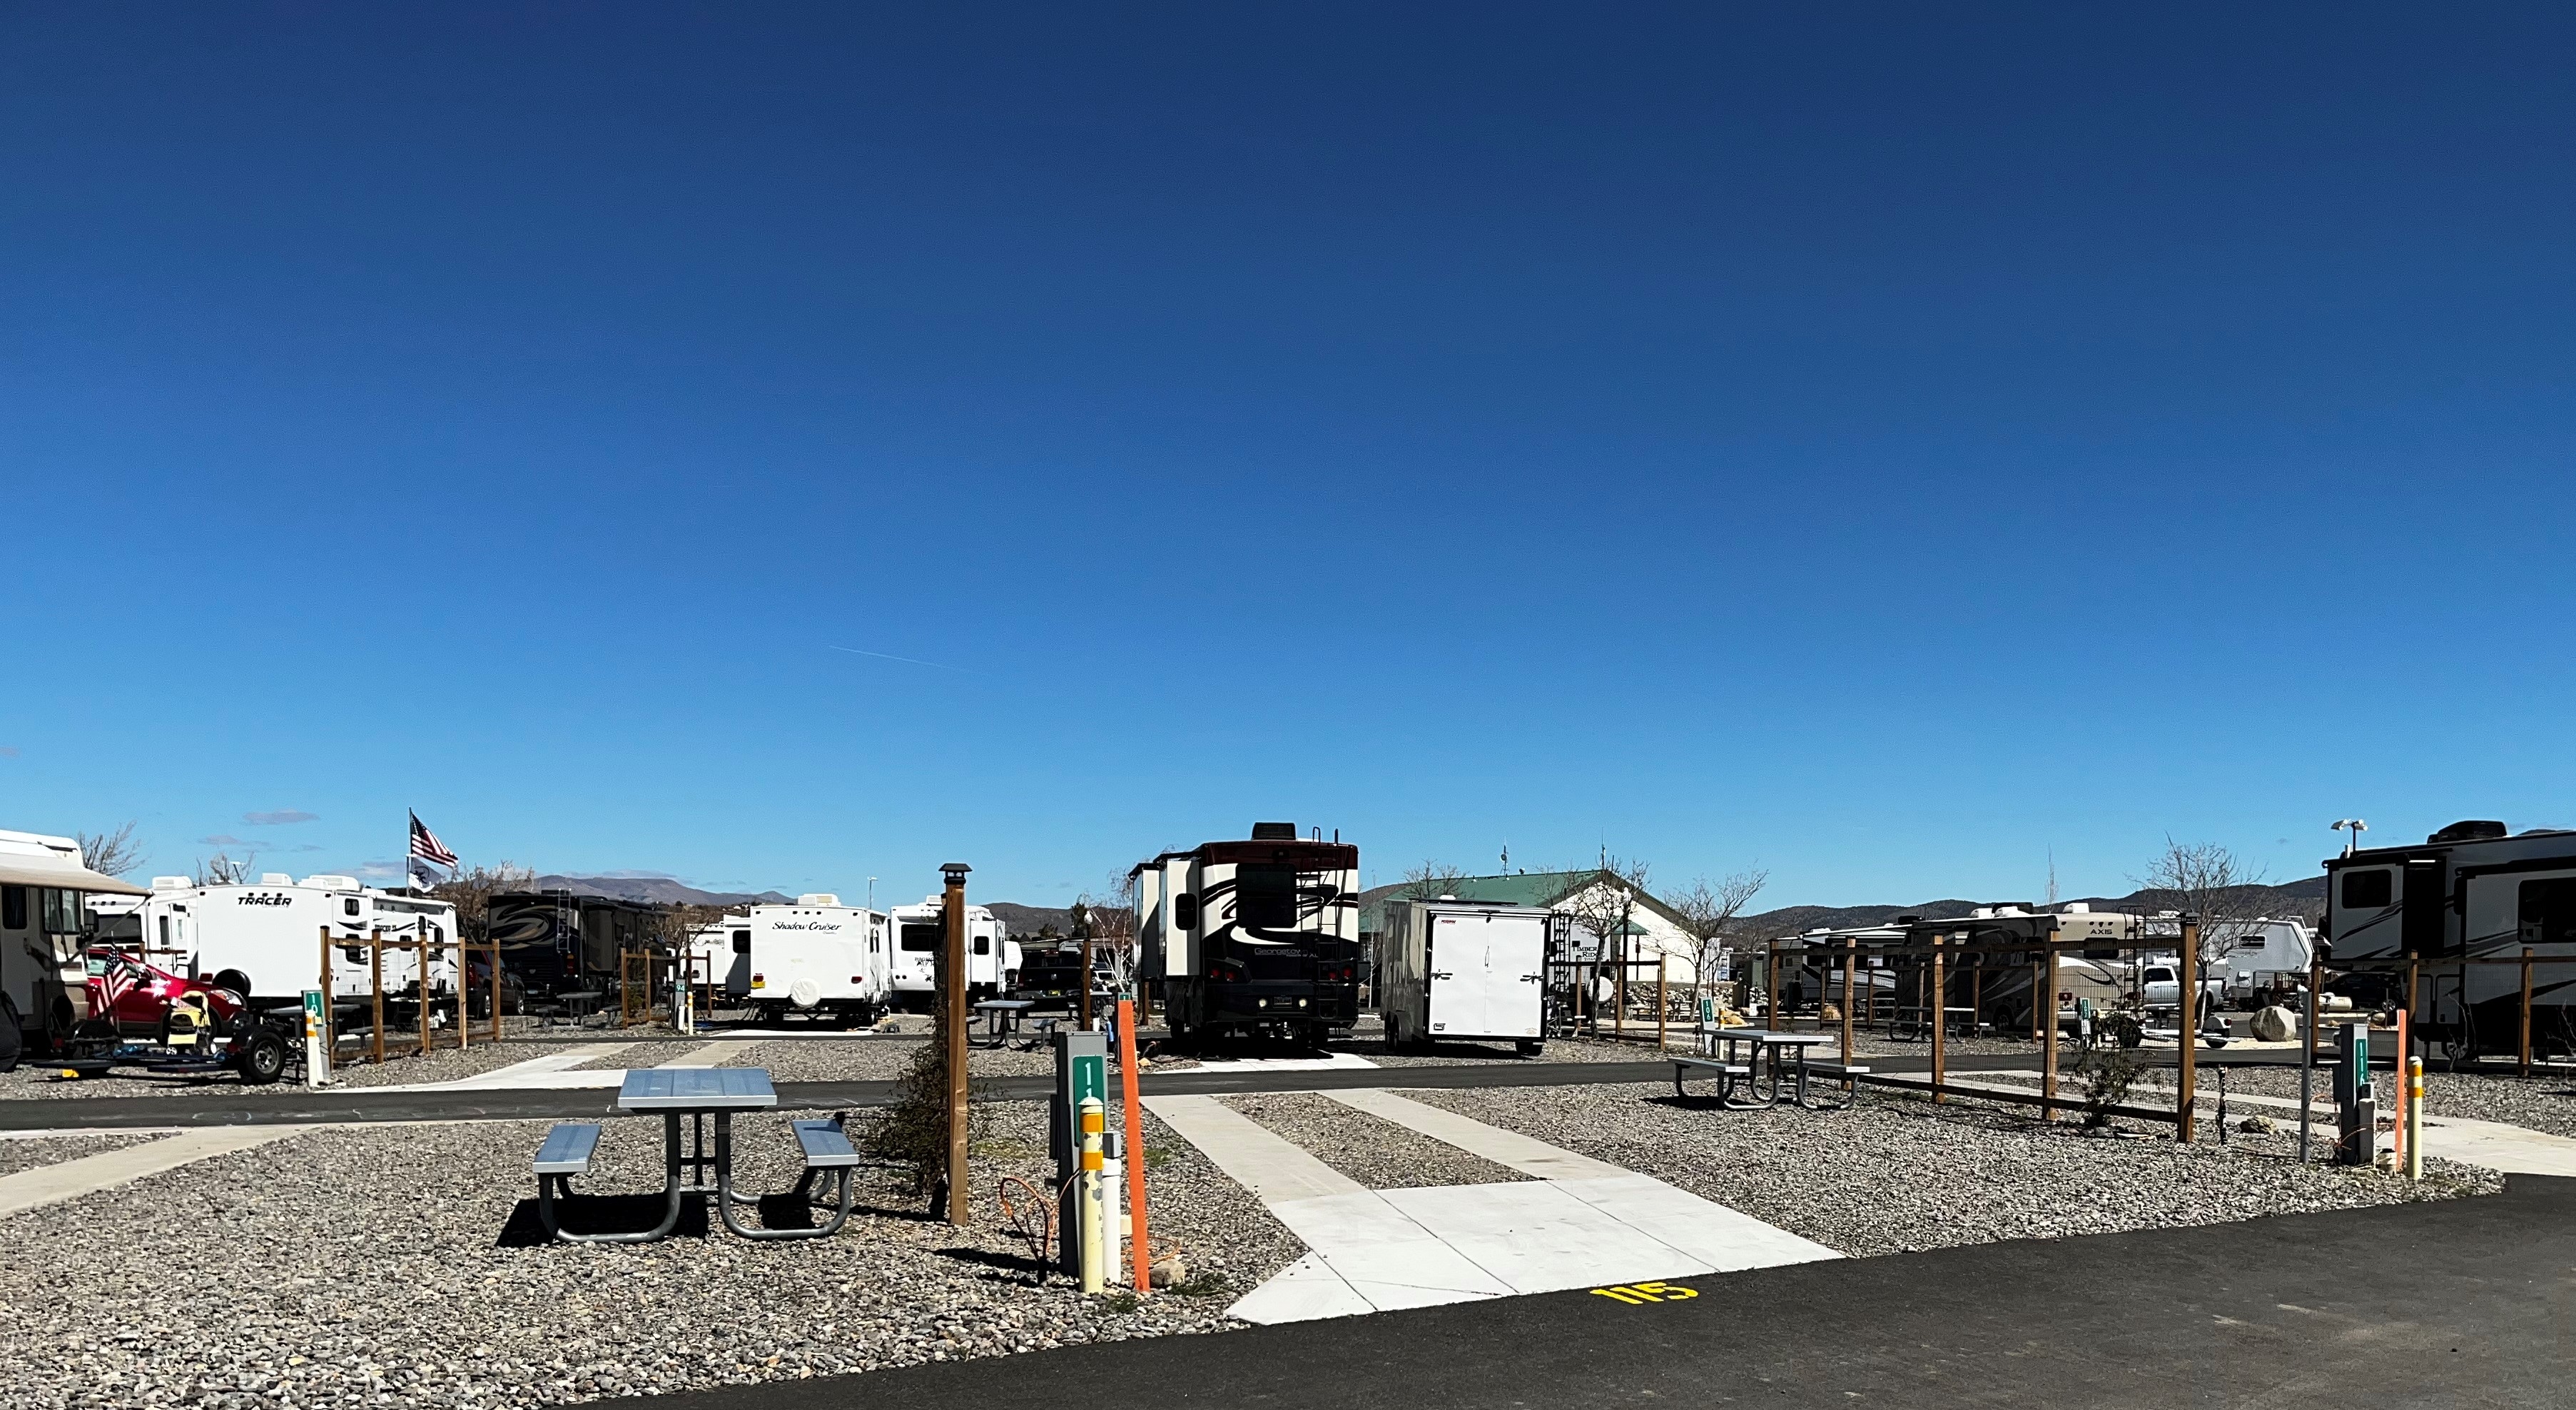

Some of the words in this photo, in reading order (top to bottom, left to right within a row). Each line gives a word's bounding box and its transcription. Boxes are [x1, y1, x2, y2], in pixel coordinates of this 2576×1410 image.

[238, 897, 292, 906] TRACER
[771, 920, 808, 930] Shadow
[808, 921, 841, 930] Cruiser
[1589, 1282, 1699, 1304] 115
